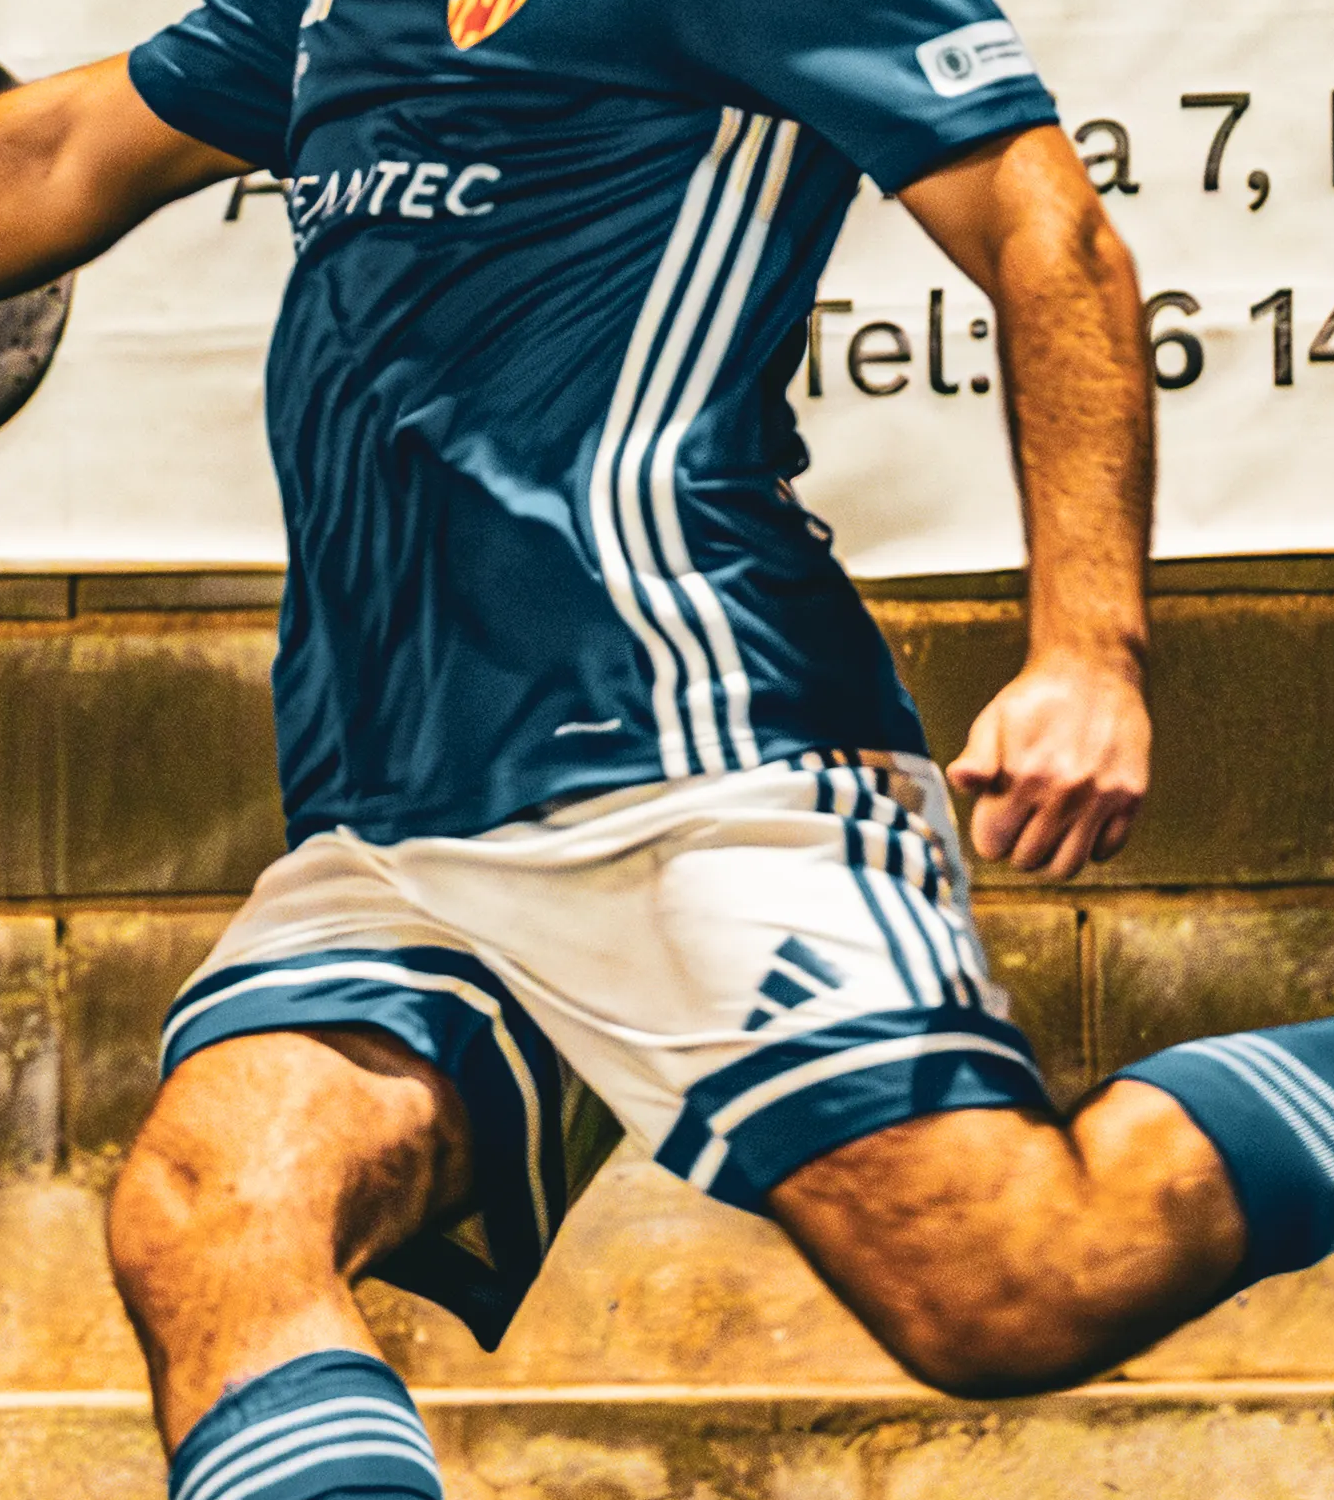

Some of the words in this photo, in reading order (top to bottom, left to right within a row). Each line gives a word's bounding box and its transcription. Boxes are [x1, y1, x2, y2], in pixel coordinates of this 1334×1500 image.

[1179, 92, 1271, 212] 7,
[805, 288, 992, 399] Tel:
[1147, 290, 1205, 390] 6
